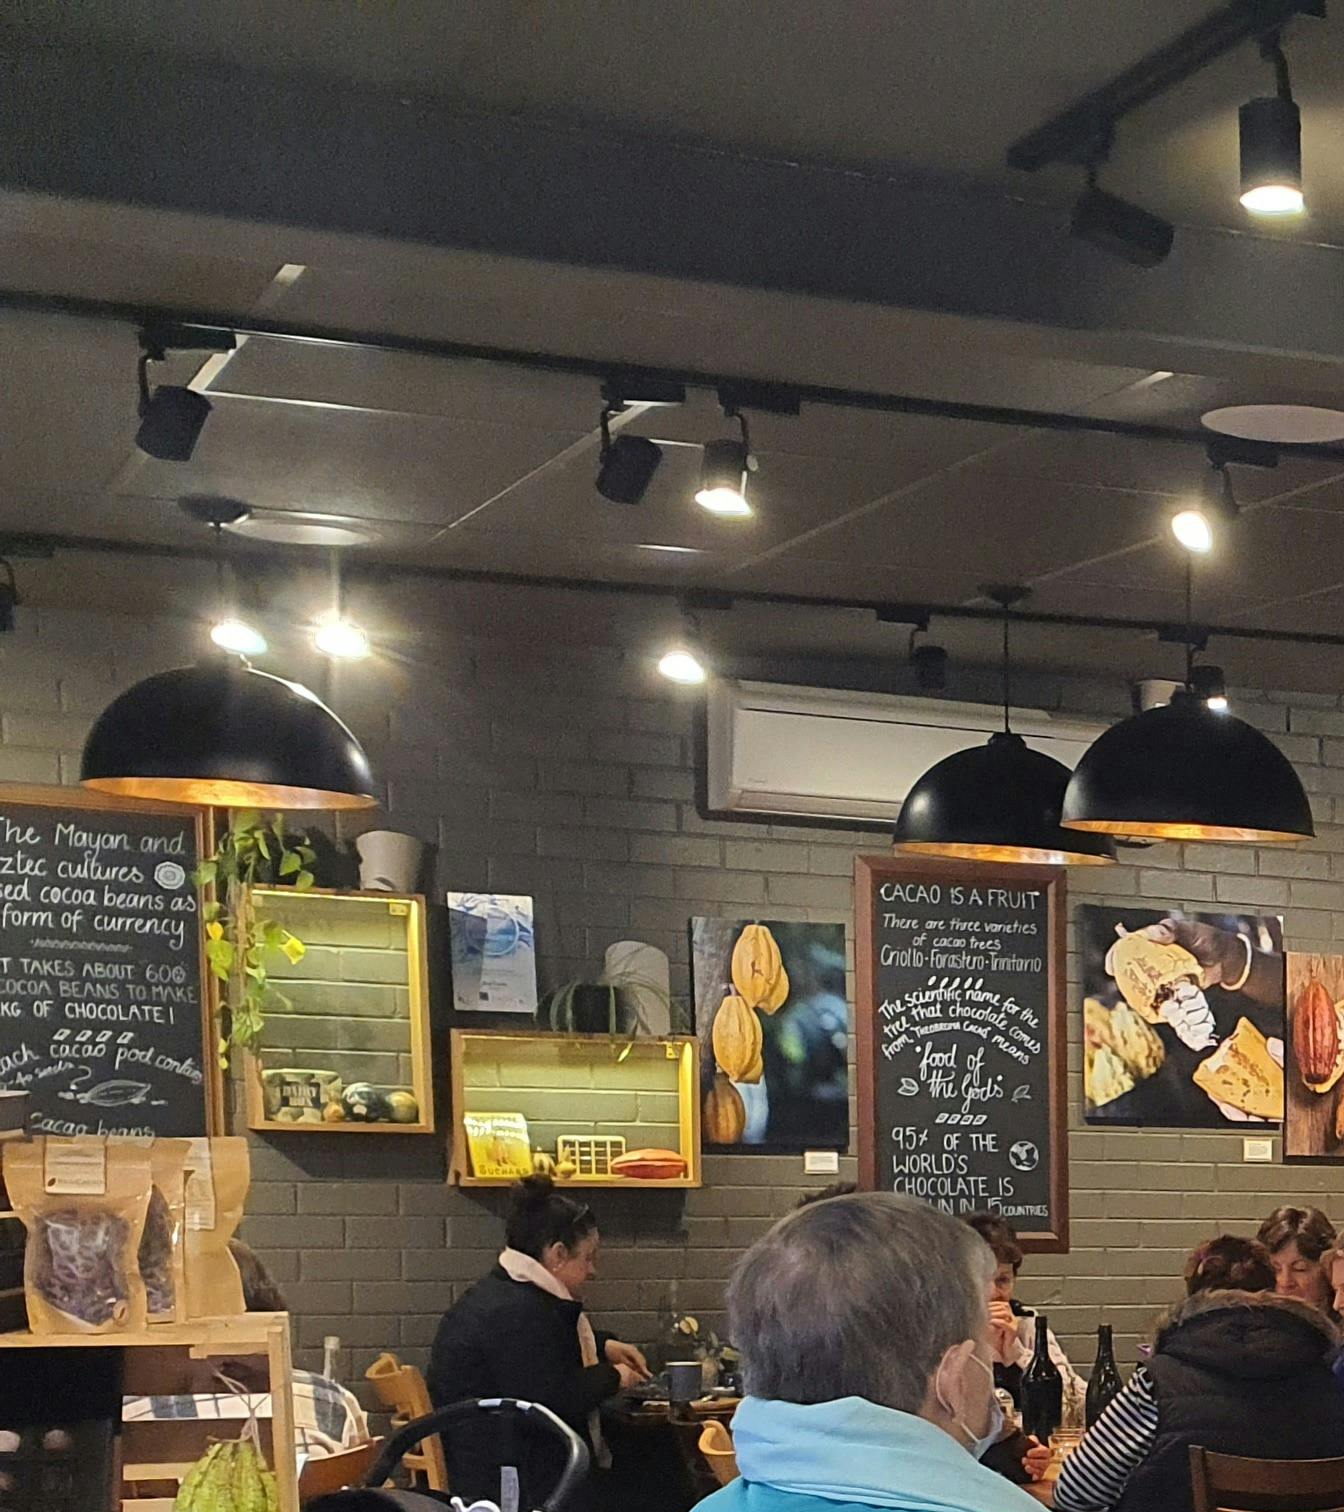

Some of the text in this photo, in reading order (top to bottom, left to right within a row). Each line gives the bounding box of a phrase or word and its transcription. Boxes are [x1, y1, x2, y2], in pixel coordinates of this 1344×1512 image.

[54, 822, 186, 861] Mayan and
[57, 856, 145, 884] cultures
[40, 885, 197, 912] cocoa beans as
[880, 883, 1040, 910] CACAO IS A FRUIT
[2, 903, 186, 951] form of currency
[883, 913, 1038, 935] There are three varieties
[912, 932, 1002, 950] of cacao trees
[20, 958, 187, 984] TAKES ABOUT 600
[0, 978, 198, 1004] COCOA BEANS TO MAKE
[33, 1001, 54, 1018] OF
[878, 985, 1040, 1029] The scientific name for the
[883, 1002, 1041, 1054] tree that chocolate comes
[50, 1043, 154, 1070] cacao pod
[881, 1033, 1030, 1065] from means
[967, 1047, 986, 1084] of
[927, 1070, 959, 1098] the
[30, 1112, 155, 1136] Cacao beans
[891, 1127, 999, 1152] 95% OF THE
[893, 1154, 969, 1175] WORLD'S
[893, 1176, 1015, 1197] CHOCOLATE IS
[1002, 1204, 1049, 1217] COUNTRIES
